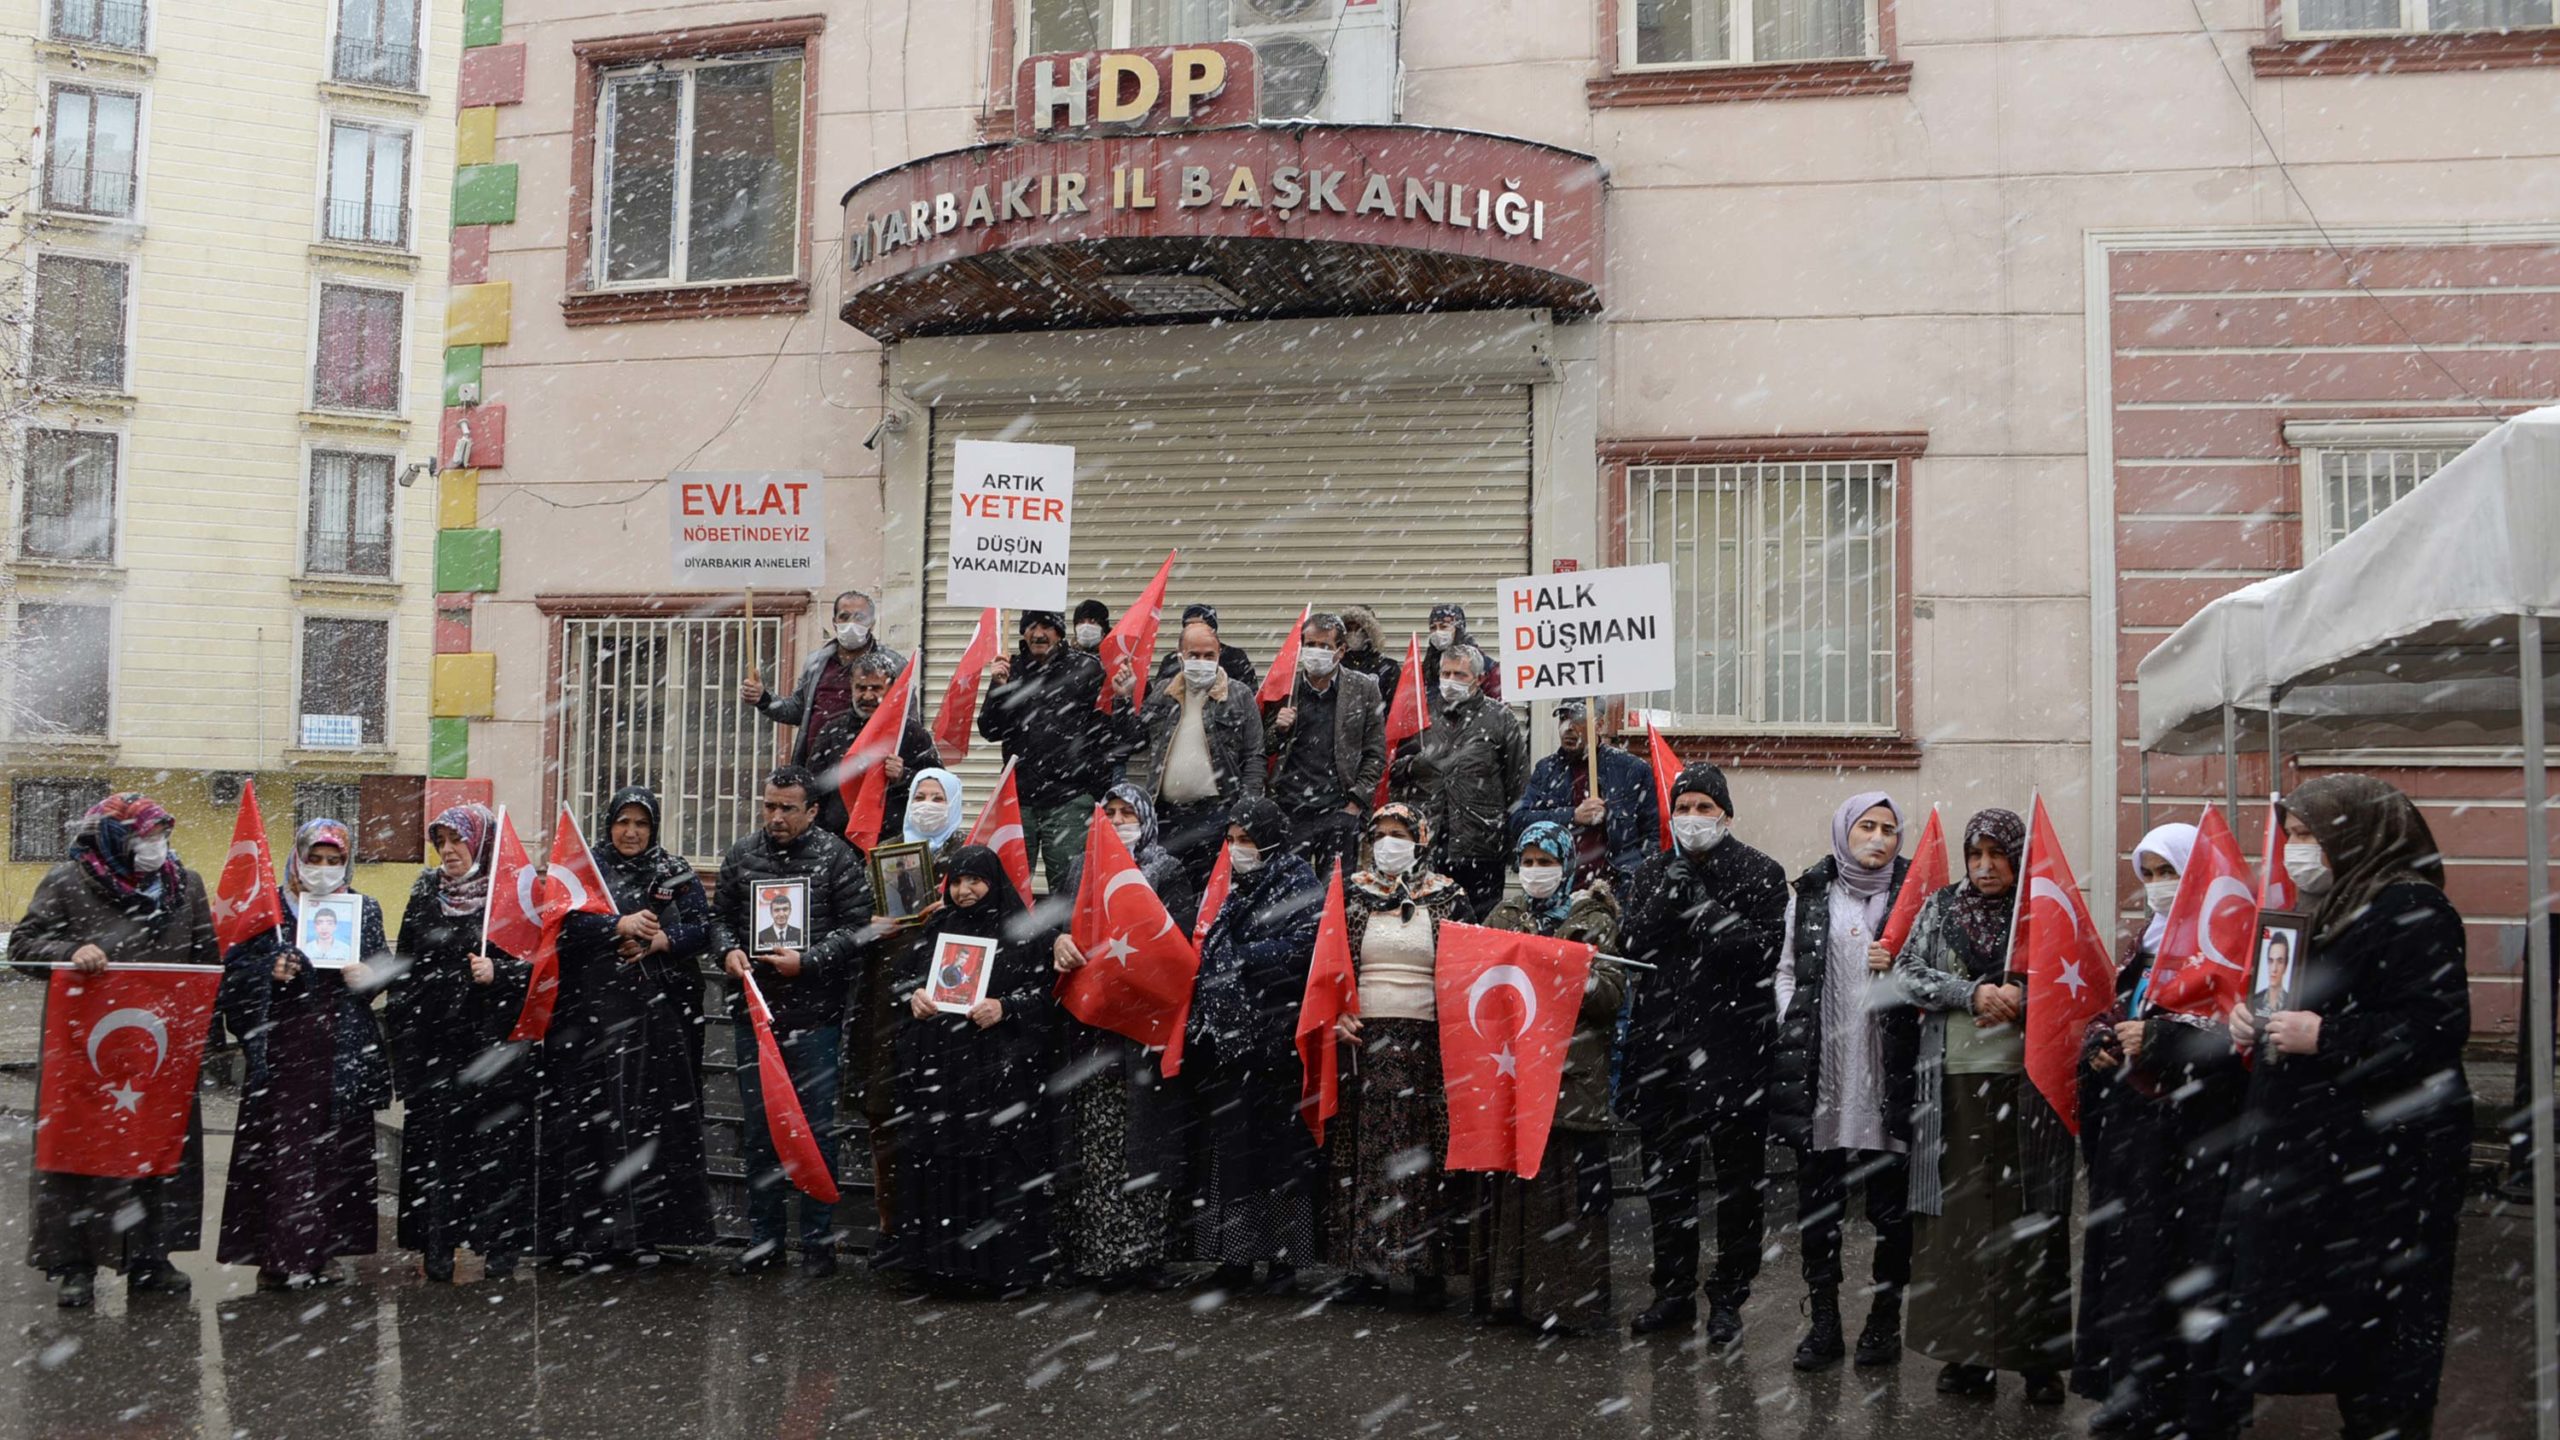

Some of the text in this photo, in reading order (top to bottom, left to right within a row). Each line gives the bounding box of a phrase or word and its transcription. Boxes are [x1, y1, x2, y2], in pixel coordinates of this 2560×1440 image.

[1034, 48, 1226, 130] HDP
[1181, 165, 1543, 240] BAŞKANLIĞI
[982, 473, 1043, 492] ARTIK
[681, 482, 808, 516] EVLAT
[960, 492, 1064, 523] YETER
[683, 523, 810, 542] NÖBETİNDEYİZ
[976, 534, 1042, 556] DÜŞÜN
[684, 555, 811, 568] DİYARBAKIR ANNELERİ
[952, 556, 1066, 577] YAKAMIZDAN
[1513, 583, 1597, 614] HALK
[1515, 615, 1656, 653] DÜŞMANI
[1517, 654, 1604, 689] PARTİ
